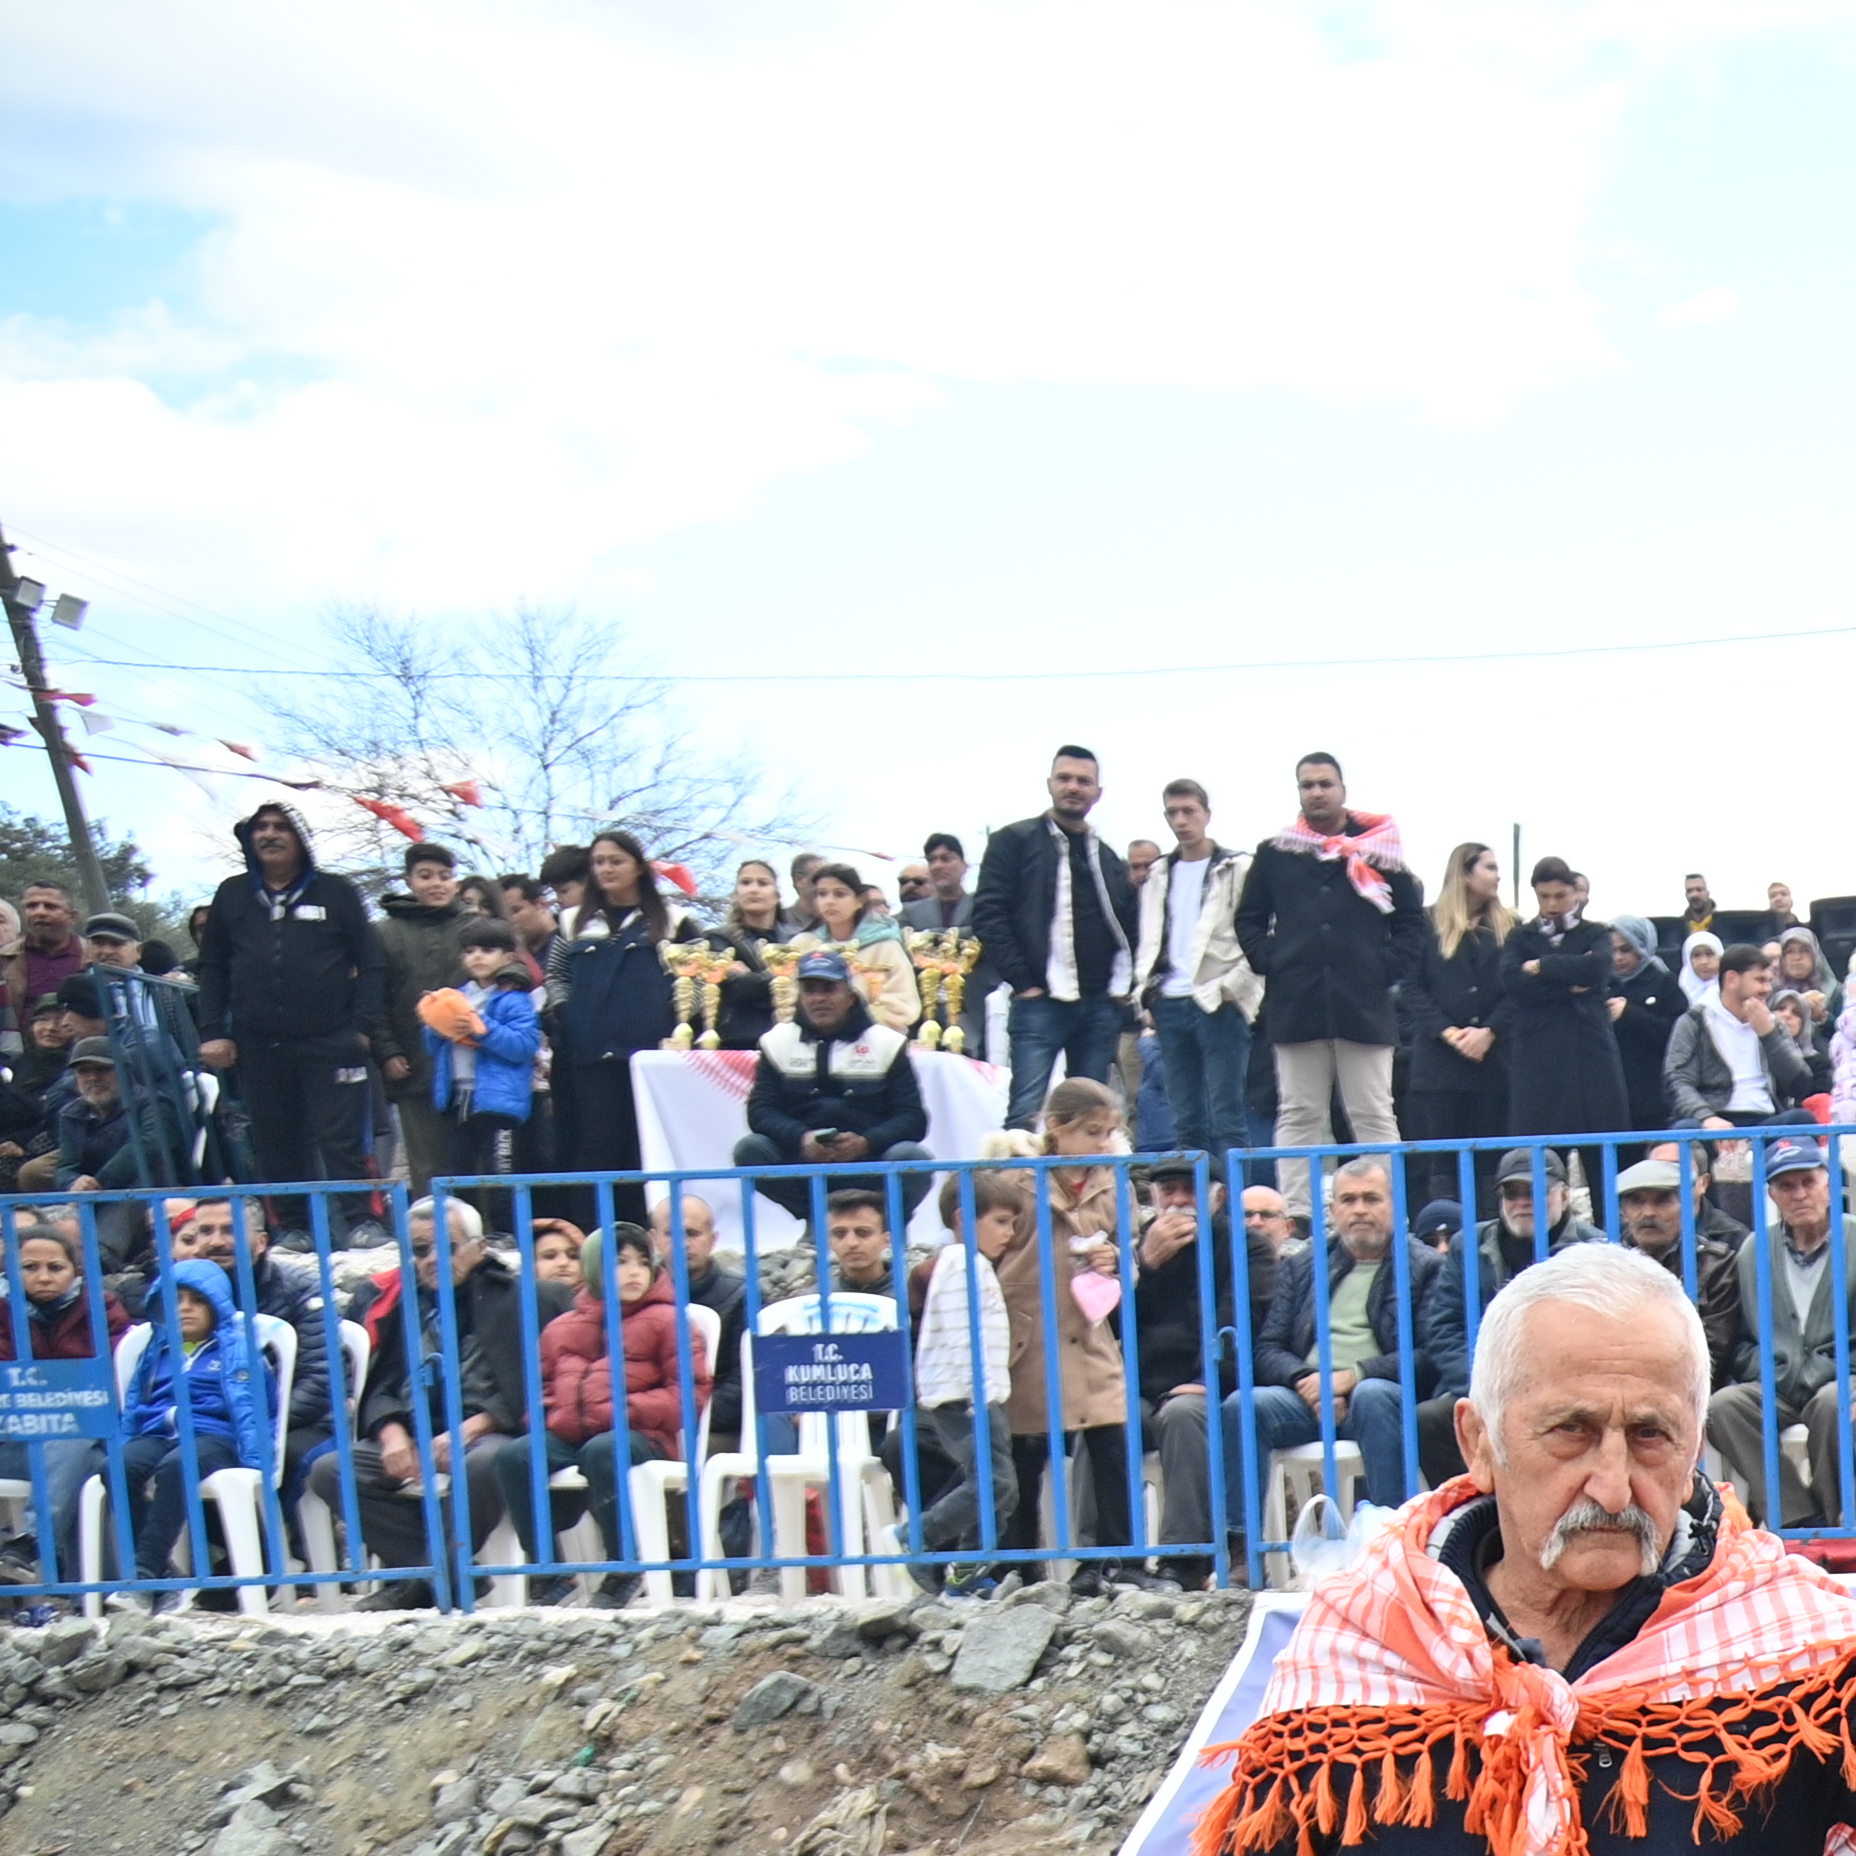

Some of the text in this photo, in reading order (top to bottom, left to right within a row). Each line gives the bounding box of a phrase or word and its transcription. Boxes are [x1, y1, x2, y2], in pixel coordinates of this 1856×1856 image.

[811, 1343, 843, 1362] T.C.
[785, 1363, 874, 1384] KUMLUCA
[786, 1382, 874, 1405] BELEDİYESİ
